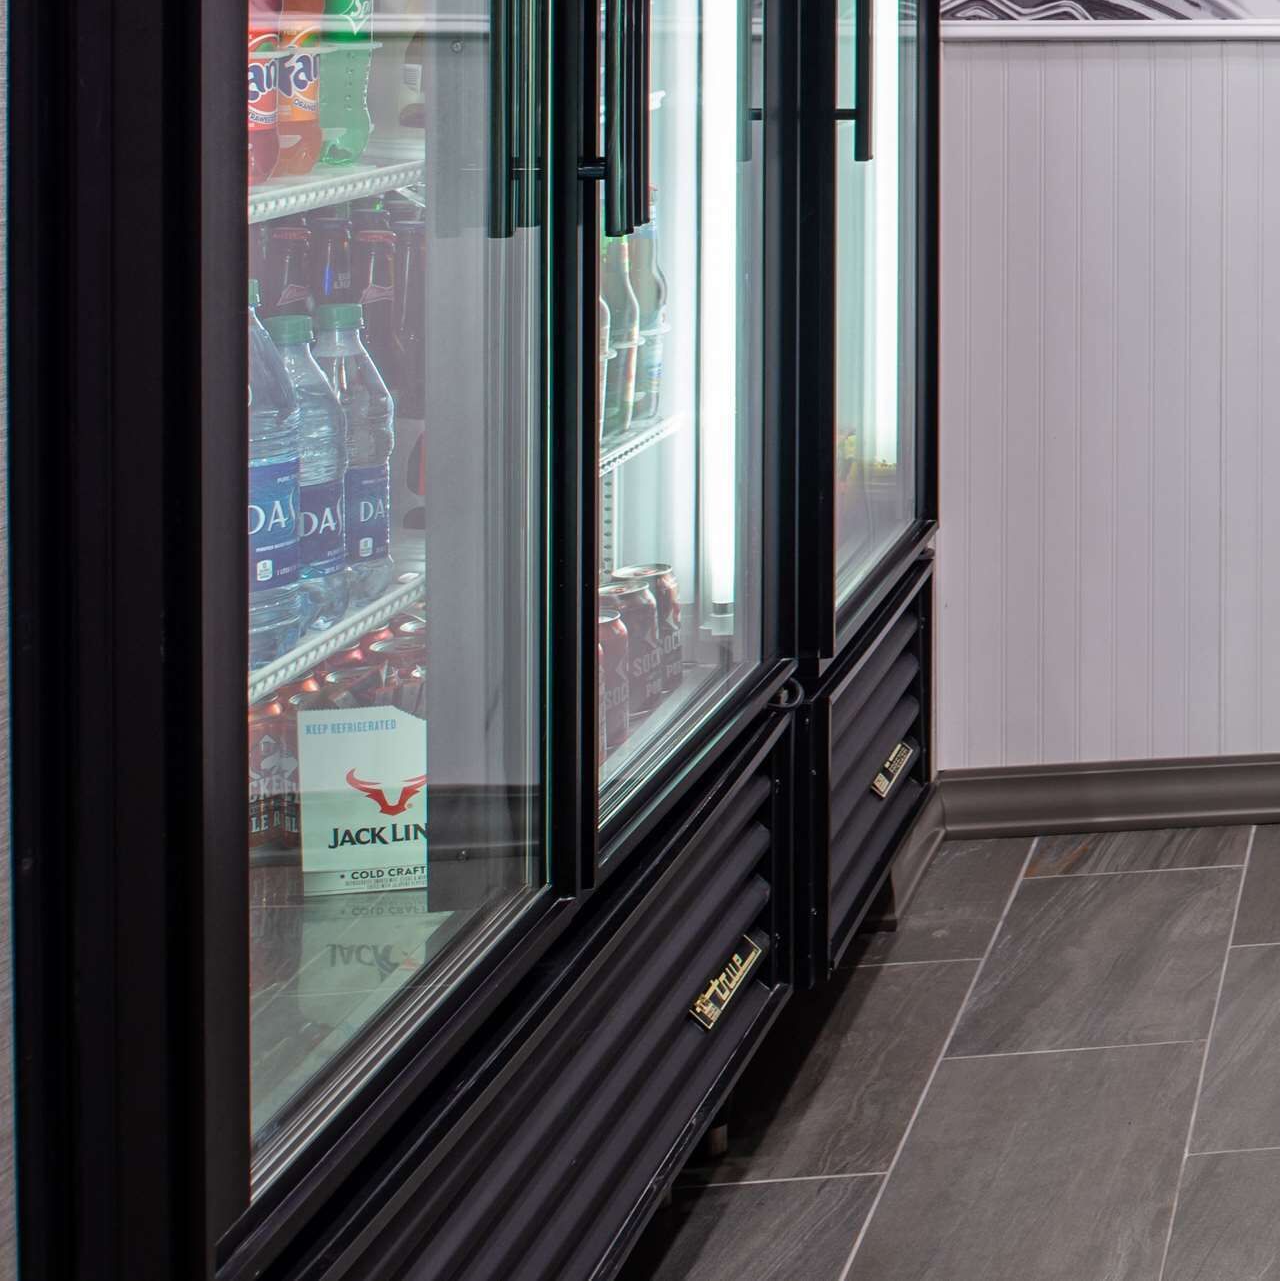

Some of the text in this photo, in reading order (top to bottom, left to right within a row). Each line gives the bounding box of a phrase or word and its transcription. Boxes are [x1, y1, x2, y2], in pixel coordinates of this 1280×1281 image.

[305, 718, 397, 736] KEEP REFRIGERATED
[328, 827, 391, 850] JACK
[351, 868, 385, 881] COLD
